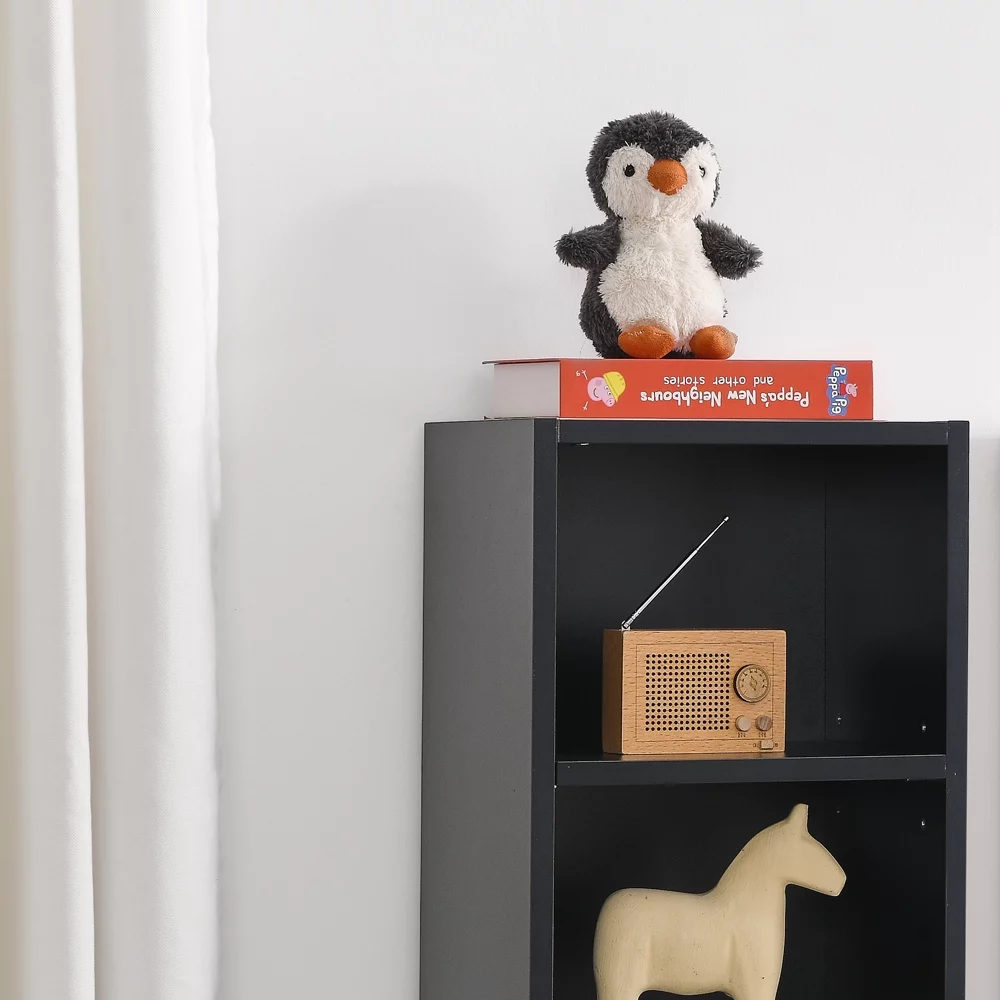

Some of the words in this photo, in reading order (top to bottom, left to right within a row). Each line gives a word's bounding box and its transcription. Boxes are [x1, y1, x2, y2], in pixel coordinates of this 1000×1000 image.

[663, 375, 706, 386] stories
[712, 375, 747, 386] other
[753, 375, 774, 386] and
[828, 366, 847, 399] Peppa
[640, 387, 722, 408] Neighbours
[727, 390, 757, 406] New
[761, 390, 810, 408] Peppa's
[831, 398, 848, 414] Pig
